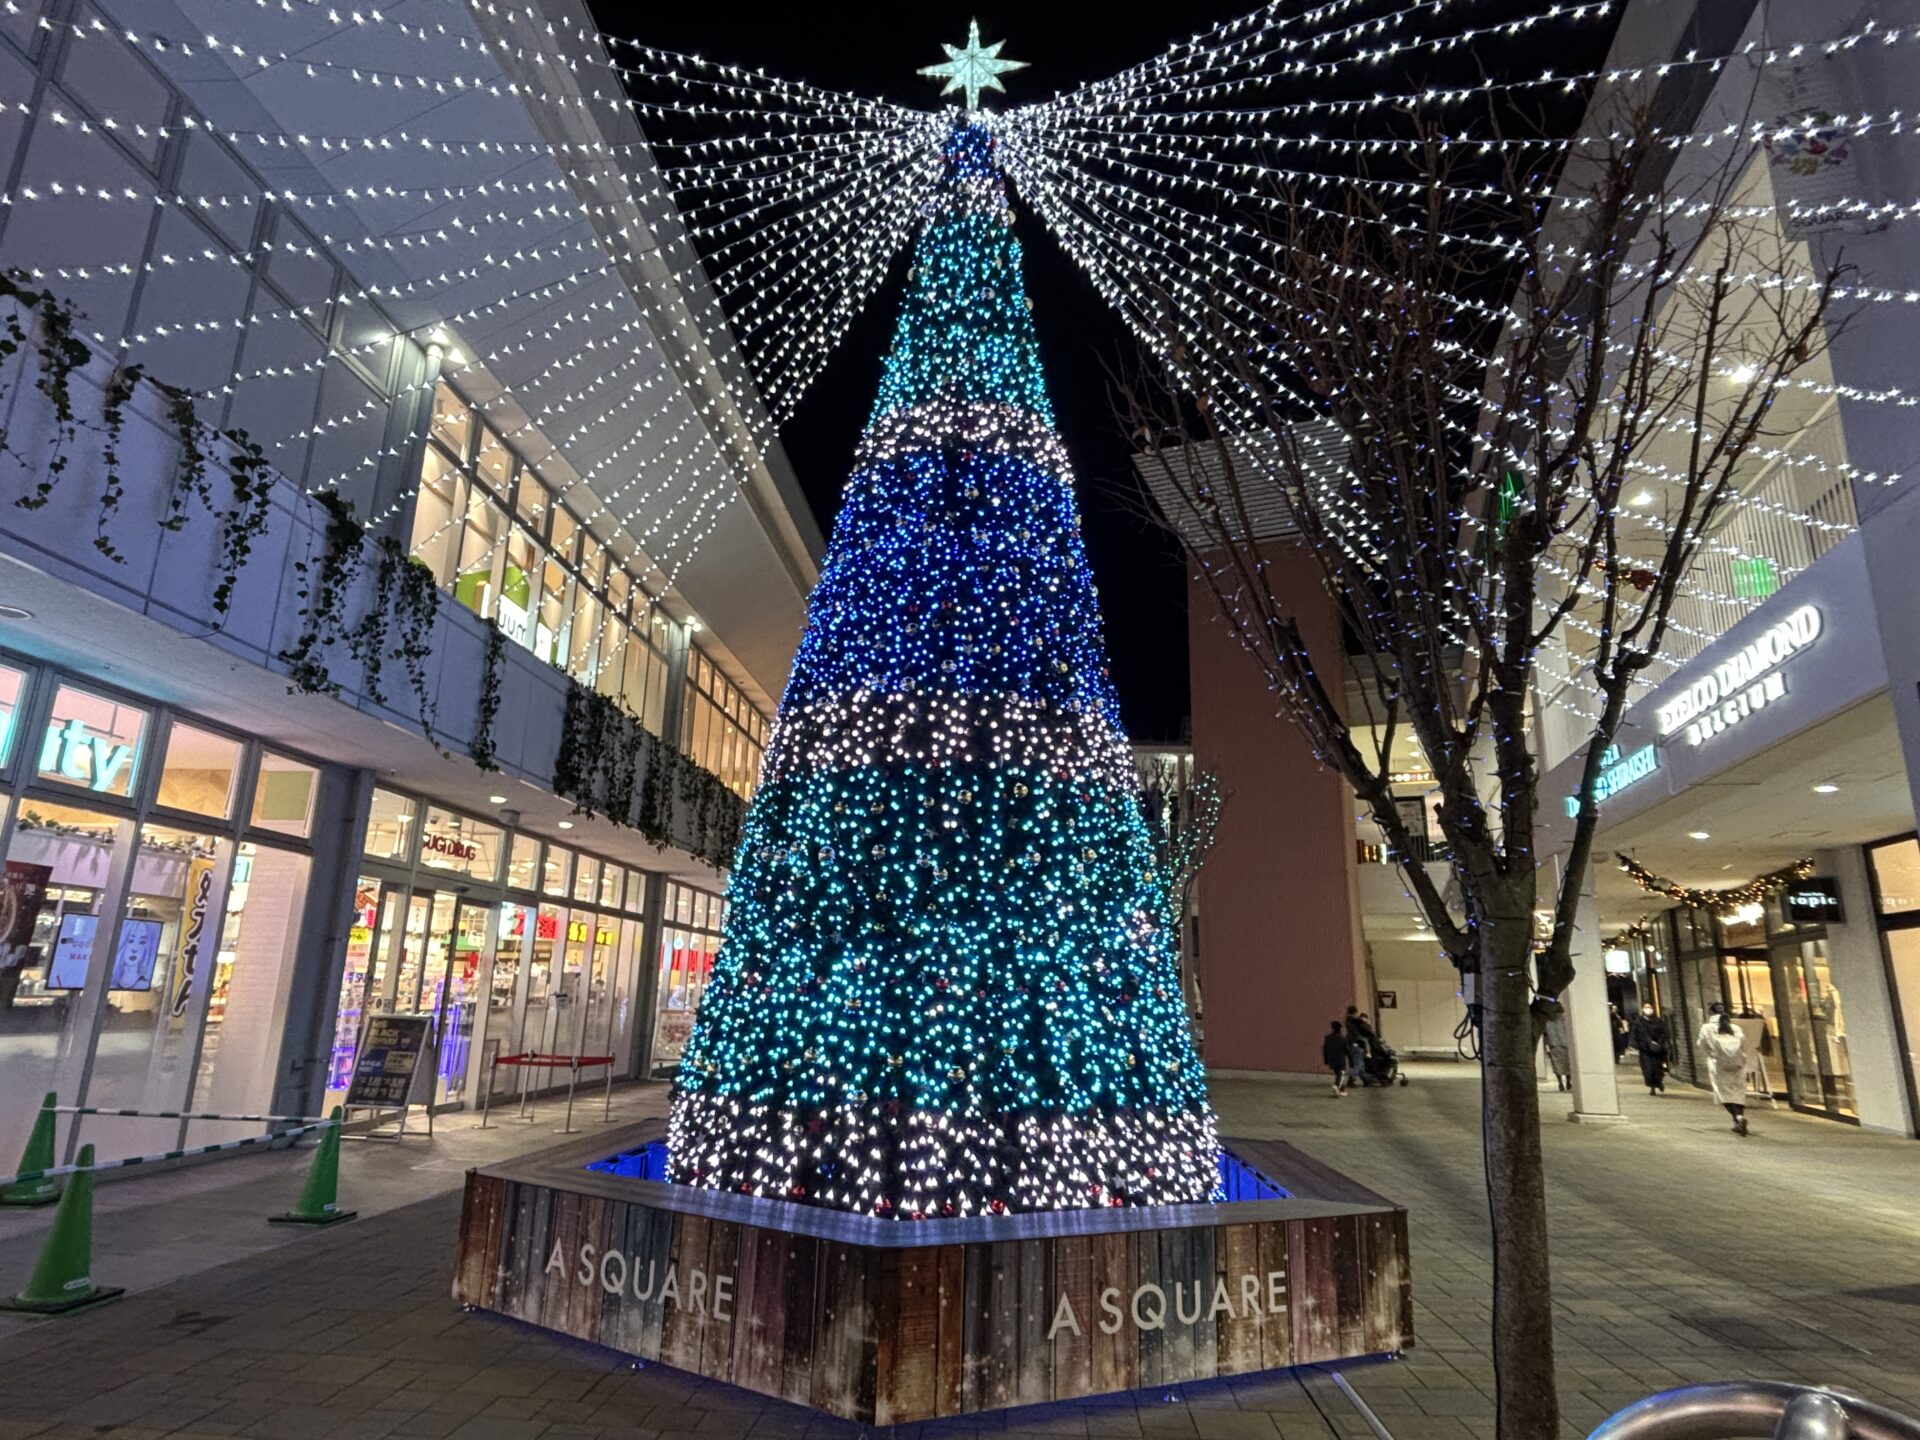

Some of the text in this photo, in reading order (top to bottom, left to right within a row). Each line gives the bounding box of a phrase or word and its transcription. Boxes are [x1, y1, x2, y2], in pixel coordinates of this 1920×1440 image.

[1655, 605, 1821, 736] EXELCO DIAMOND
[1686, 671, 1787, 746] BELGIUM
[447, 838, 477, 861] DRUG
[1789, 895, 1838, 908] topic
[545, 1238, 735, 1321] A SQUARE
[1048, 1271, 1288, 1340] A SQUARE
